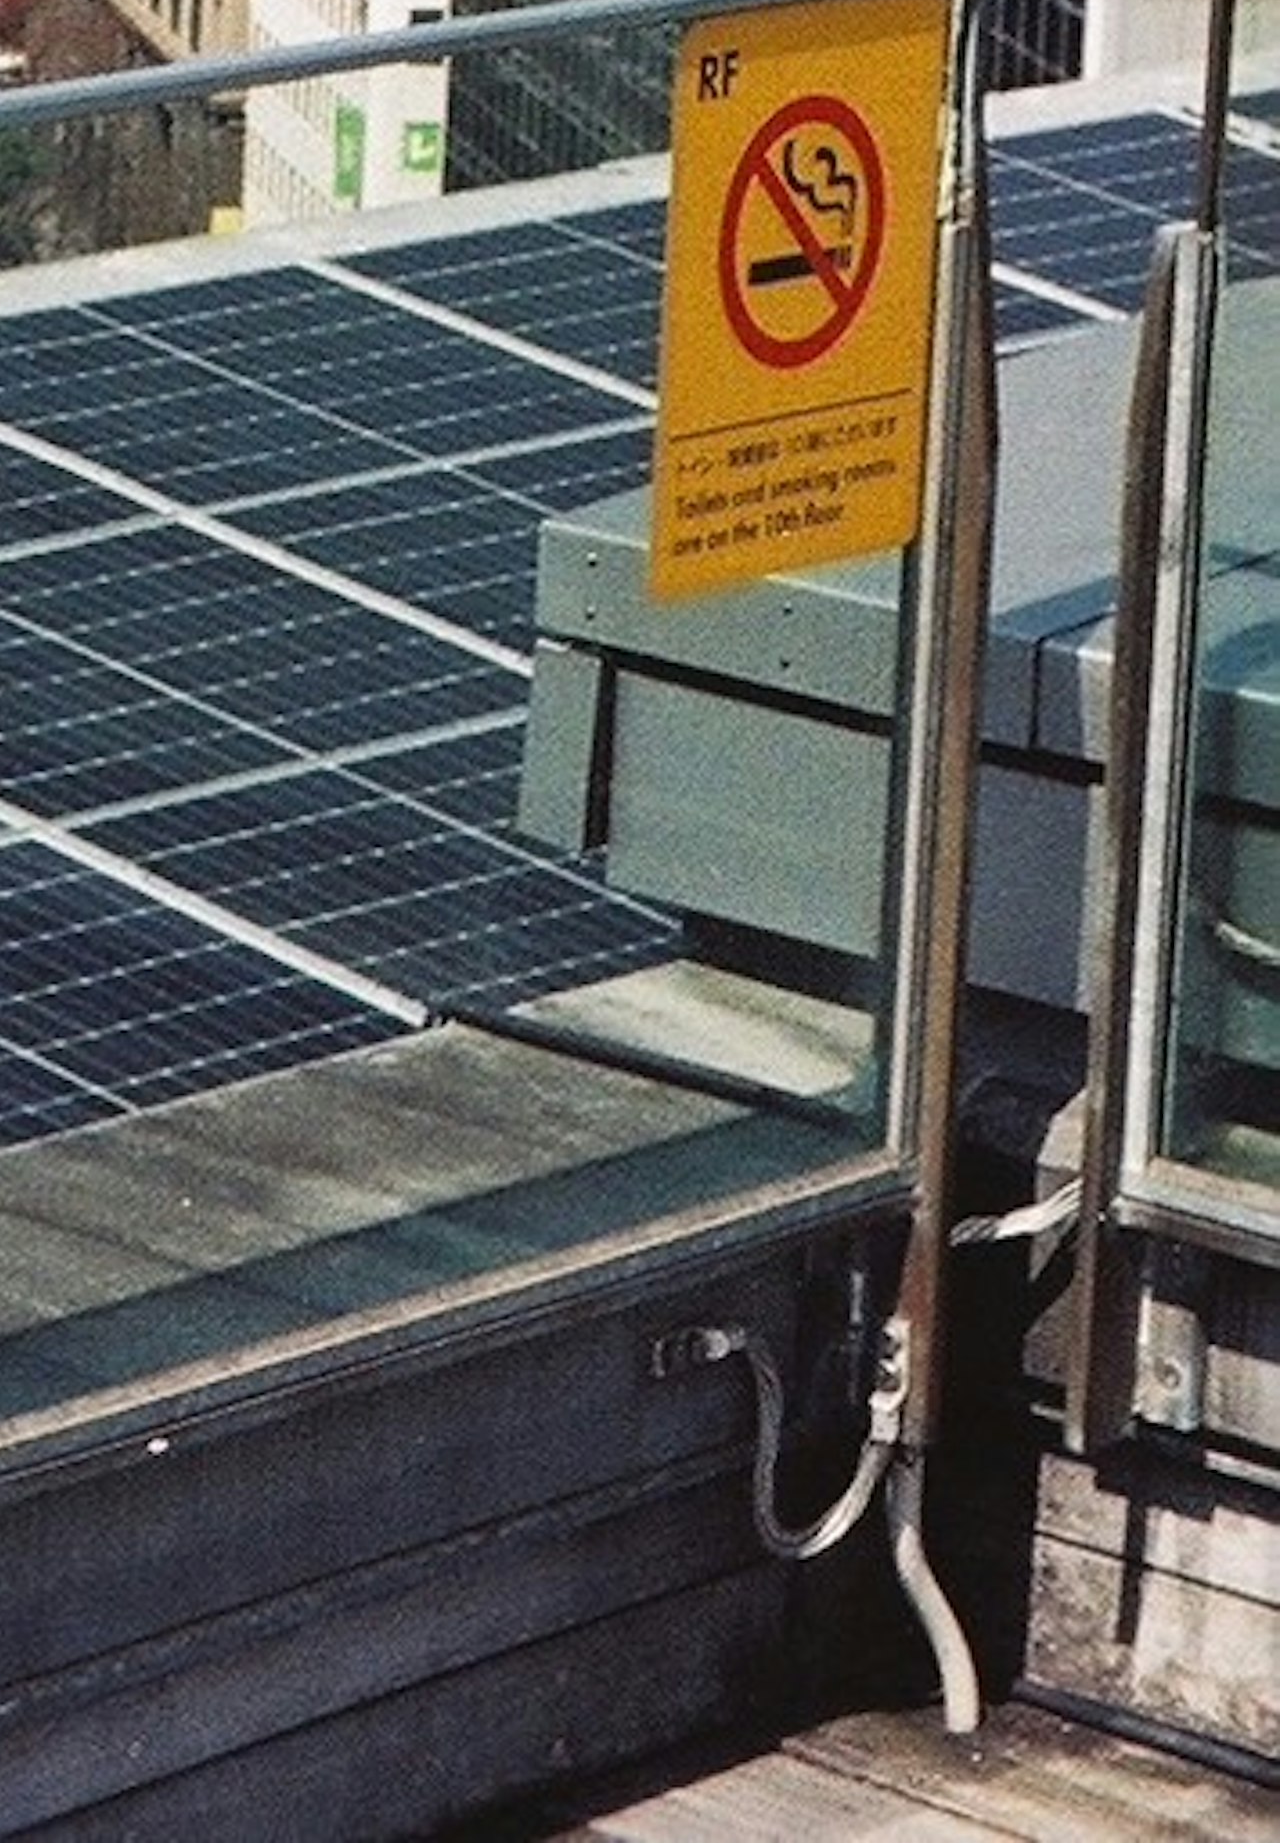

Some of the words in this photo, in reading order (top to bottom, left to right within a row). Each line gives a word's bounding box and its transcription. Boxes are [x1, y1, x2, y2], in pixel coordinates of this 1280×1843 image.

[695, 49, 741, 103] RF
[731, 482, 766, 507] and
[769, 466, 840, 494] smoking
[706, 529, 729, 551] on
[731, 518, 760, 542] the
